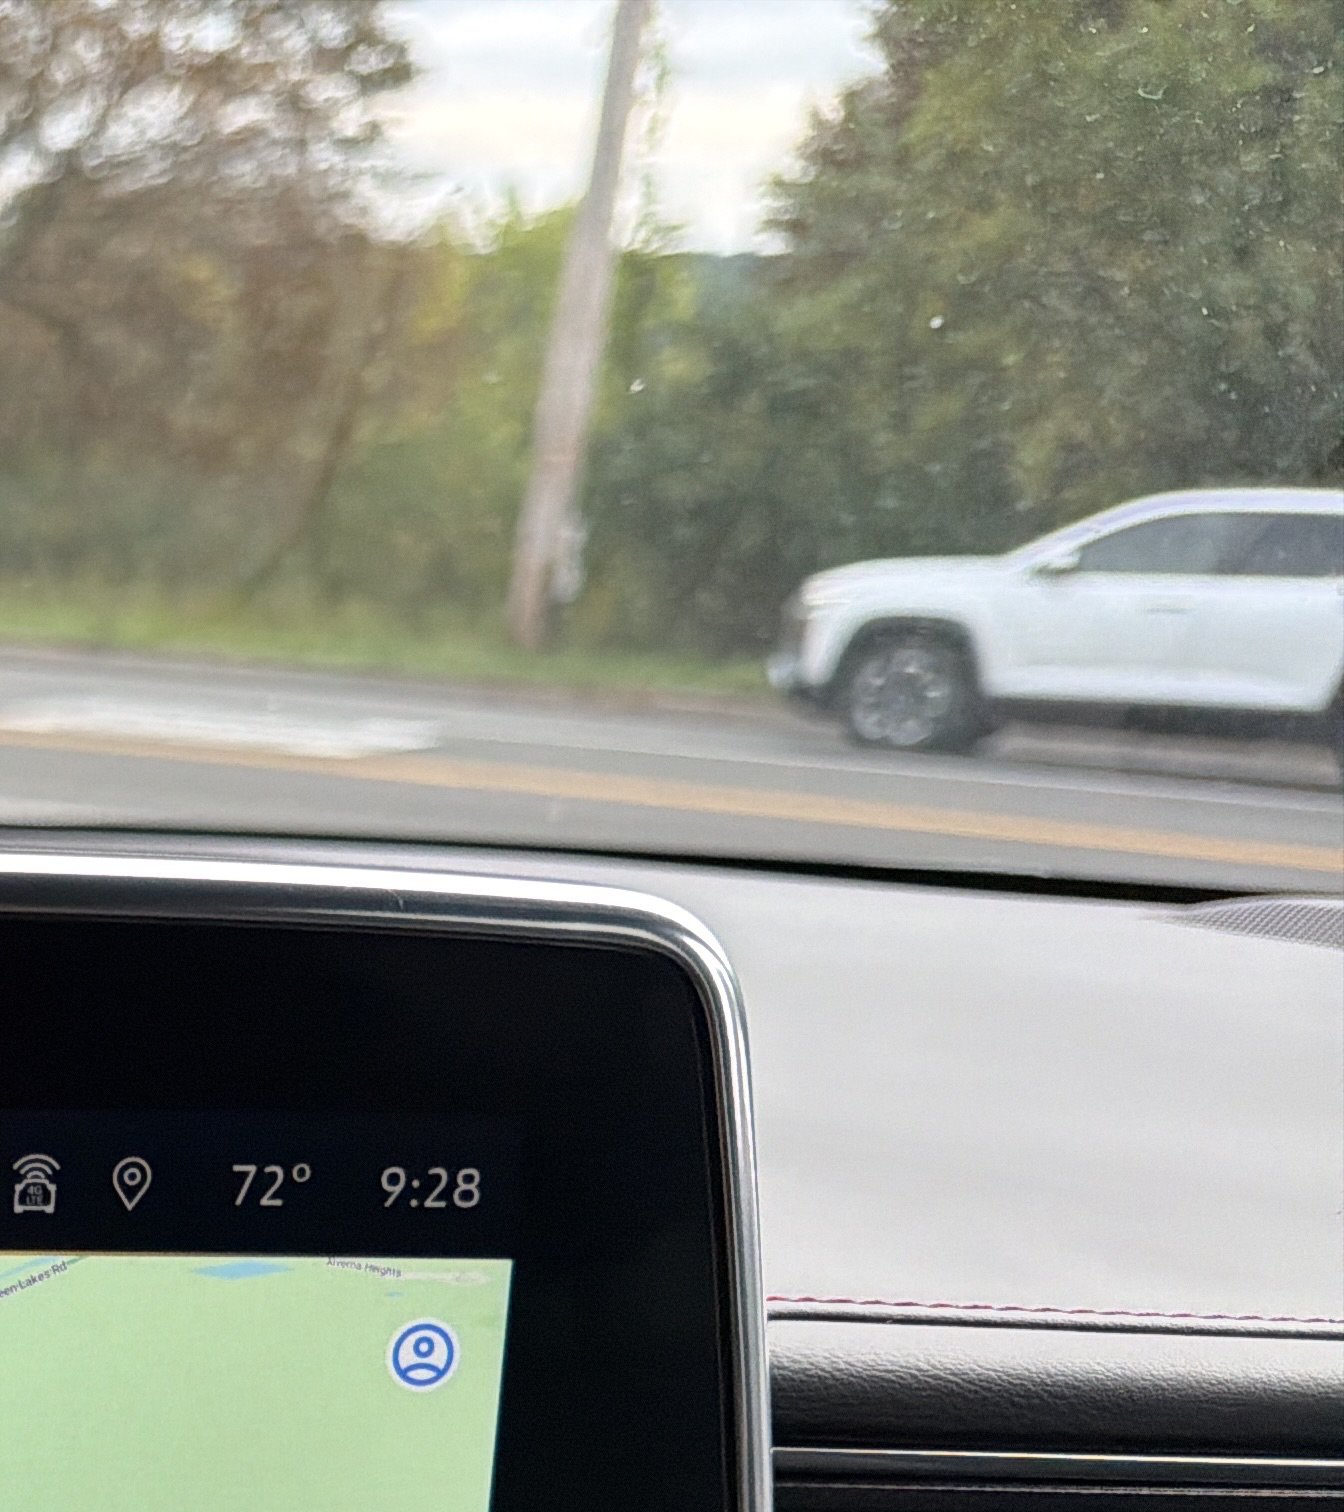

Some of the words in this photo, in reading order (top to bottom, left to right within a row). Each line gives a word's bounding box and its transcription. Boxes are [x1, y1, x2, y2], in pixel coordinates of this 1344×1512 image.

[380, 1167, 481, 1208] 9:28
[17, 1269, 51, 1290] Lakes
[50, 1261, 68, 1275] Rd
